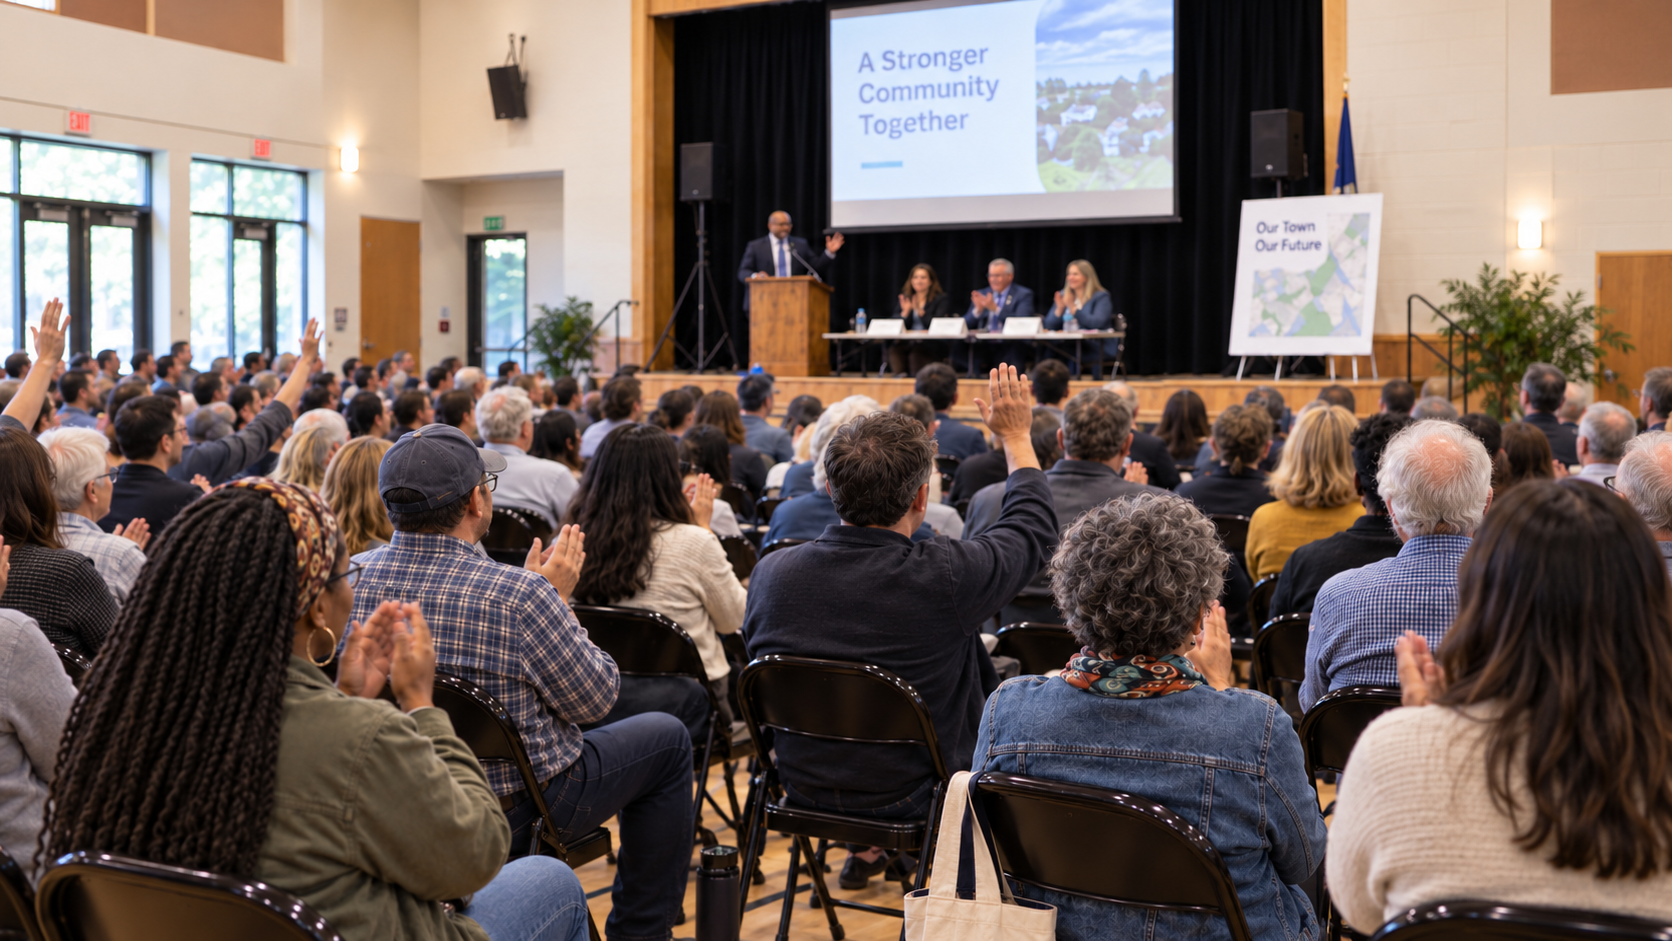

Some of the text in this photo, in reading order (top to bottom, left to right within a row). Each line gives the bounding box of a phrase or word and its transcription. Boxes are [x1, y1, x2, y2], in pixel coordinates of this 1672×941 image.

[858, 47, 989, 73] A Stronger
[858, 75, 999, 104] Community
[858, 109, 969, 139] Together
[1256, 220, 1316, 234] Our Town
[1255, 239, 1322, 252] Our Future
